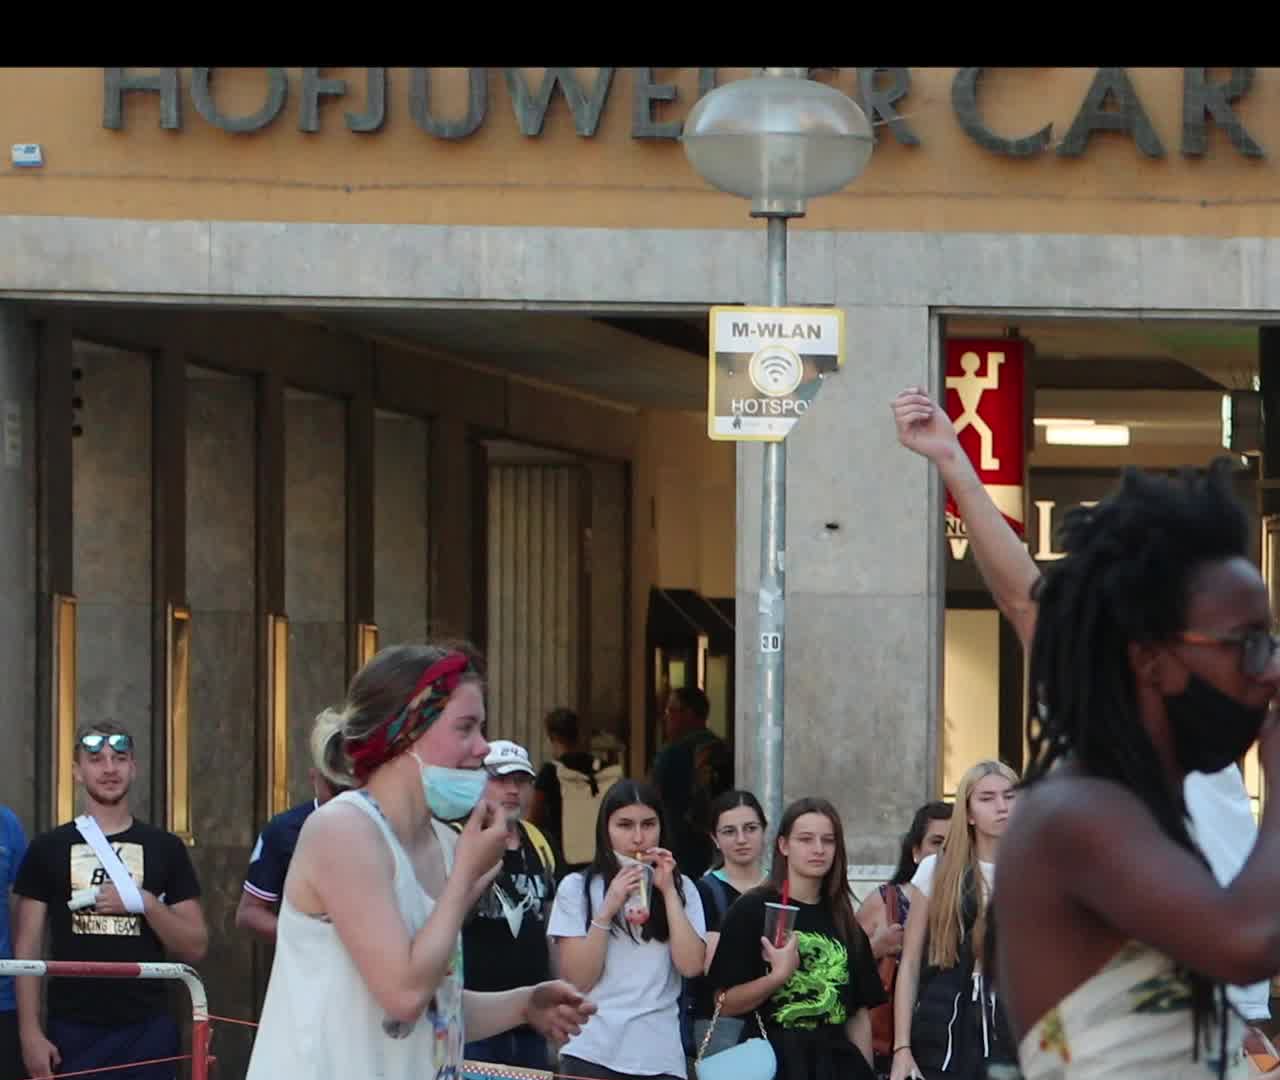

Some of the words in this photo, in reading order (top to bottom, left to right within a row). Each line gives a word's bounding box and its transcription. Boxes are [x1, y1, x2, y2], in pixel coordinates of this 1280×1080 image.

[102, 67, 920, 146] HOFJUWER
[732, 321, 822, 340] M-WLAN
[731, 399, 811, 415] HOTSPO
